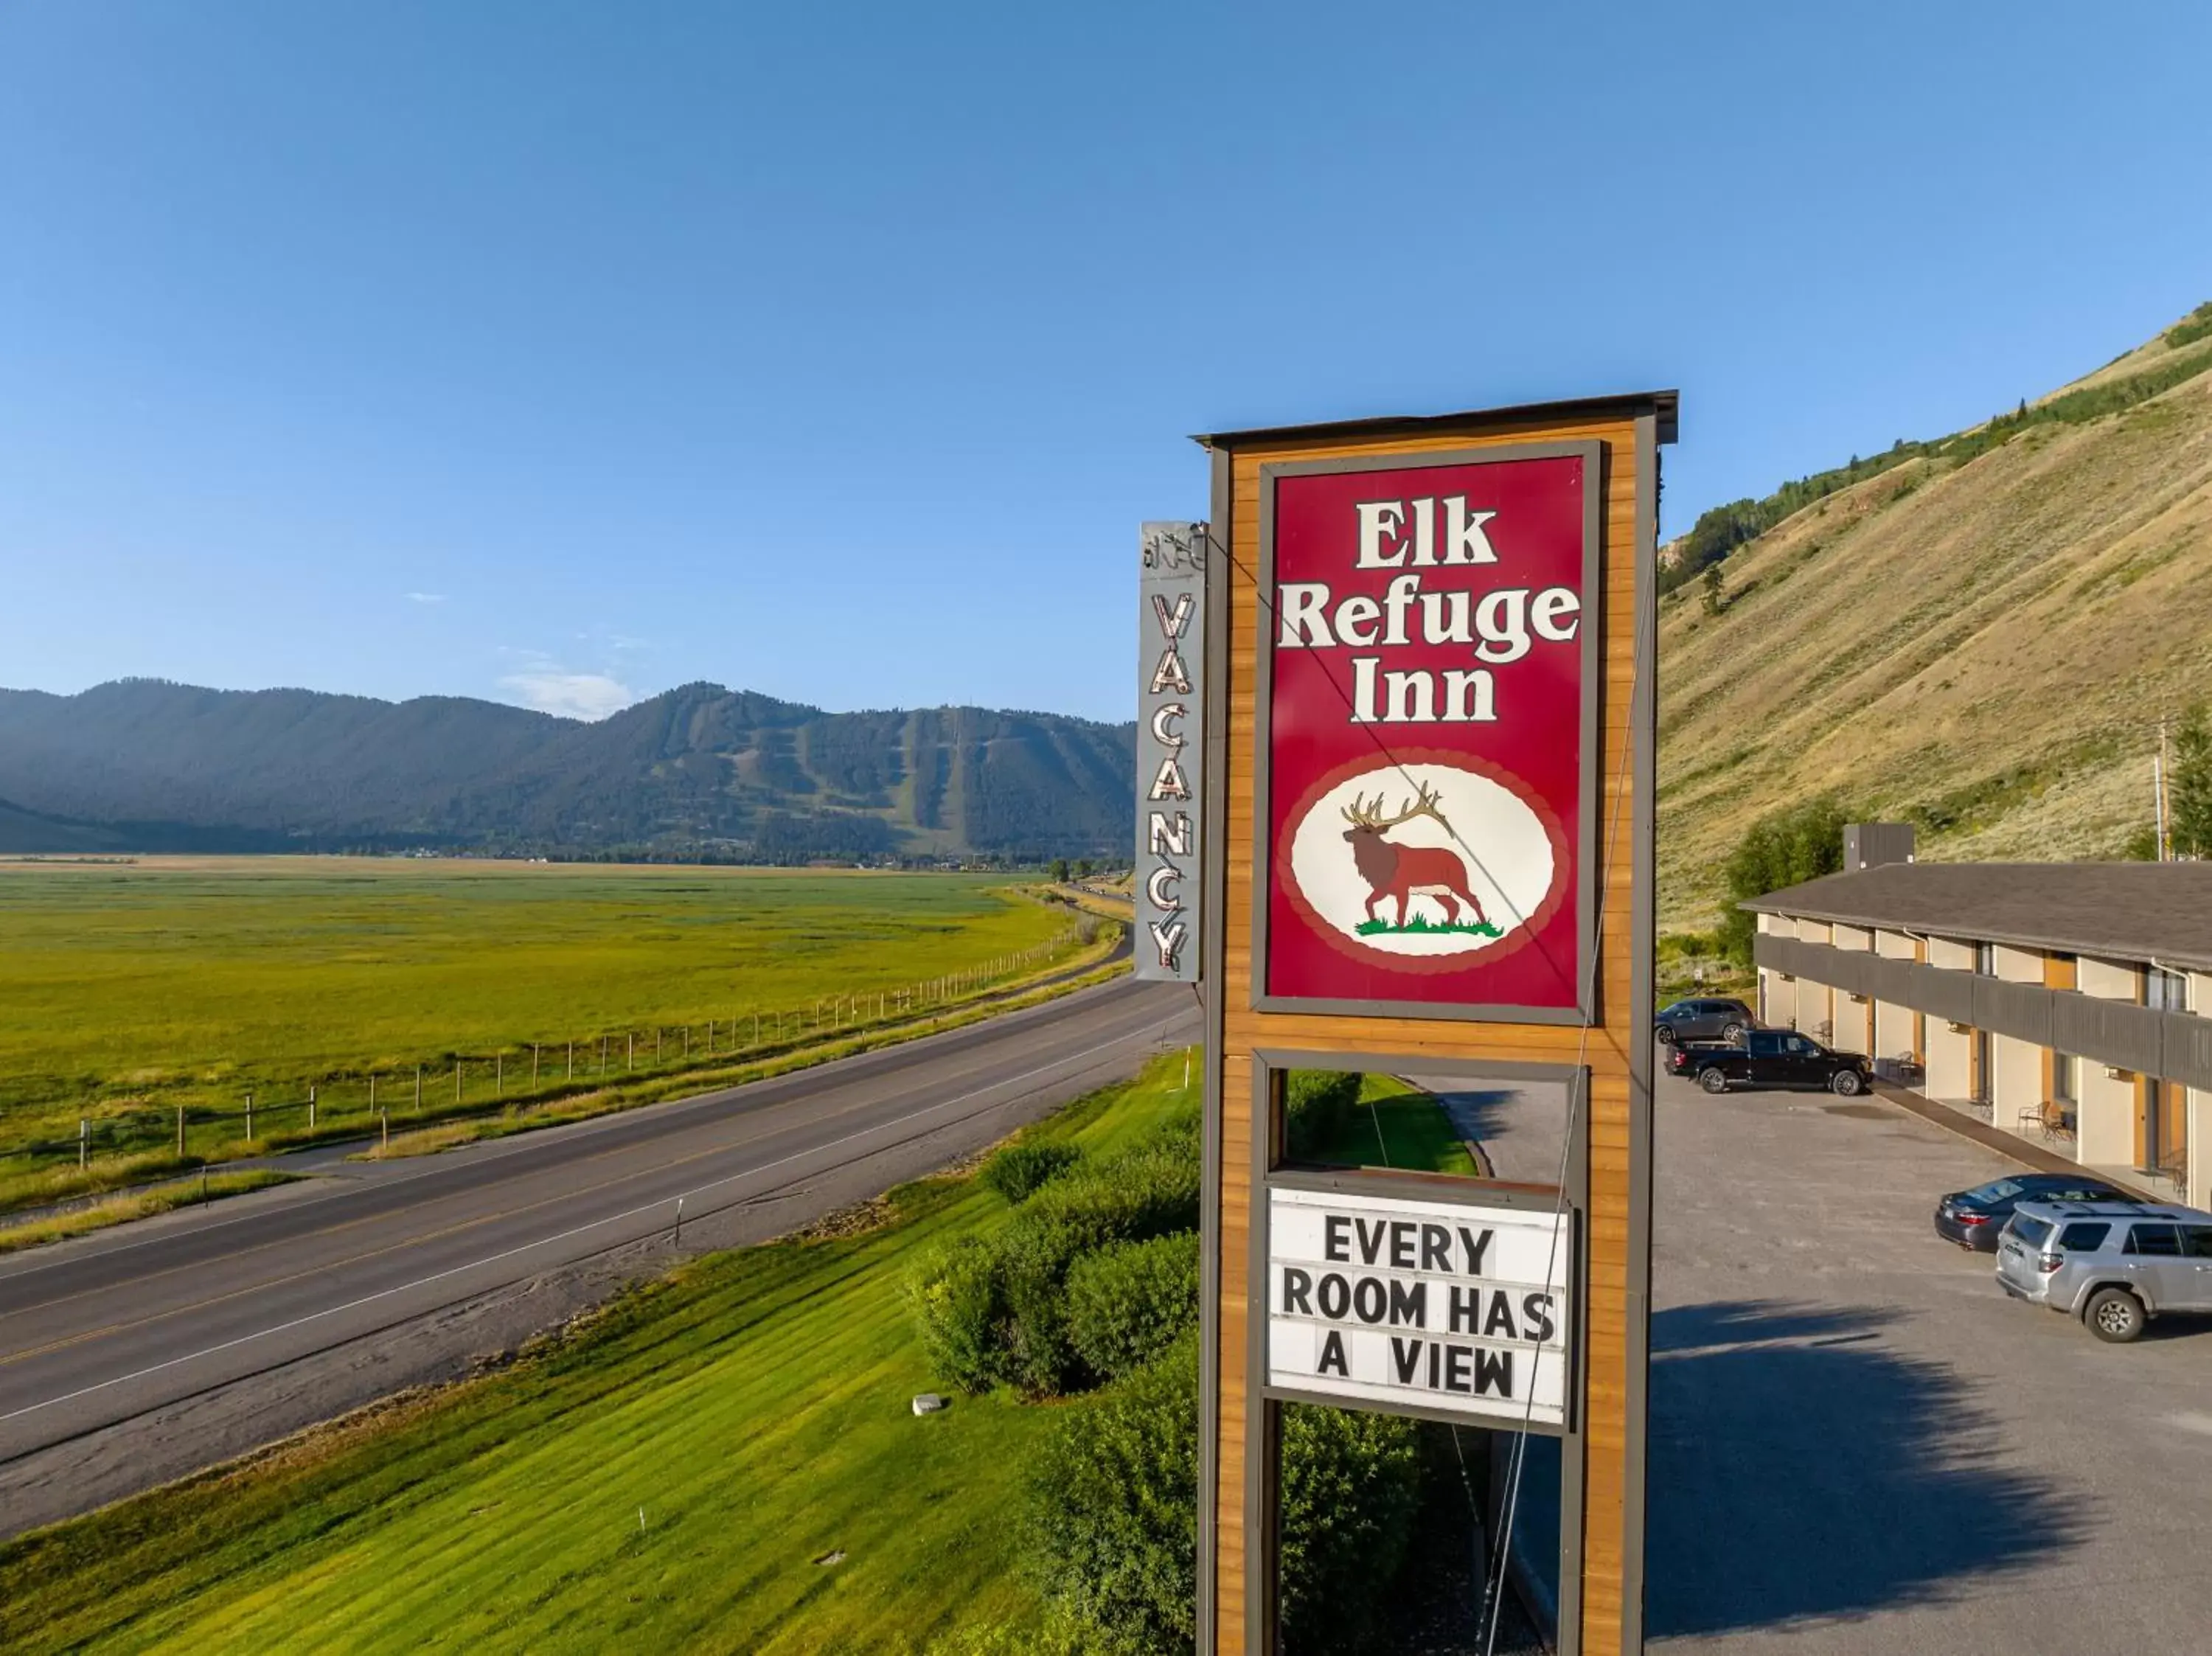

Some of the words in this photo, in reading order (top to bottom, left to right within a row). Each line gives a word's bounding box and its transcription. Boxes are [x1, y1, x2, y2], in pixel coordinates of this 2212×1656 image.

[1355, 495, 1498, 569] Elk
[1277, 574, 1581, 664] Refuge
[1350, 656, 1498, 723] Inn
[1147, 593, 1193, 969] VACANCY
[1325, 1214, 1495, 1276] EVERY
[1283, 1267, 1427, 1329] ROOM
[1450, 1285, 1554, 1342] HAS
[1317, 1329, 1349, 1377] A
[1391, 1336, 1512, 1398] VIEW
